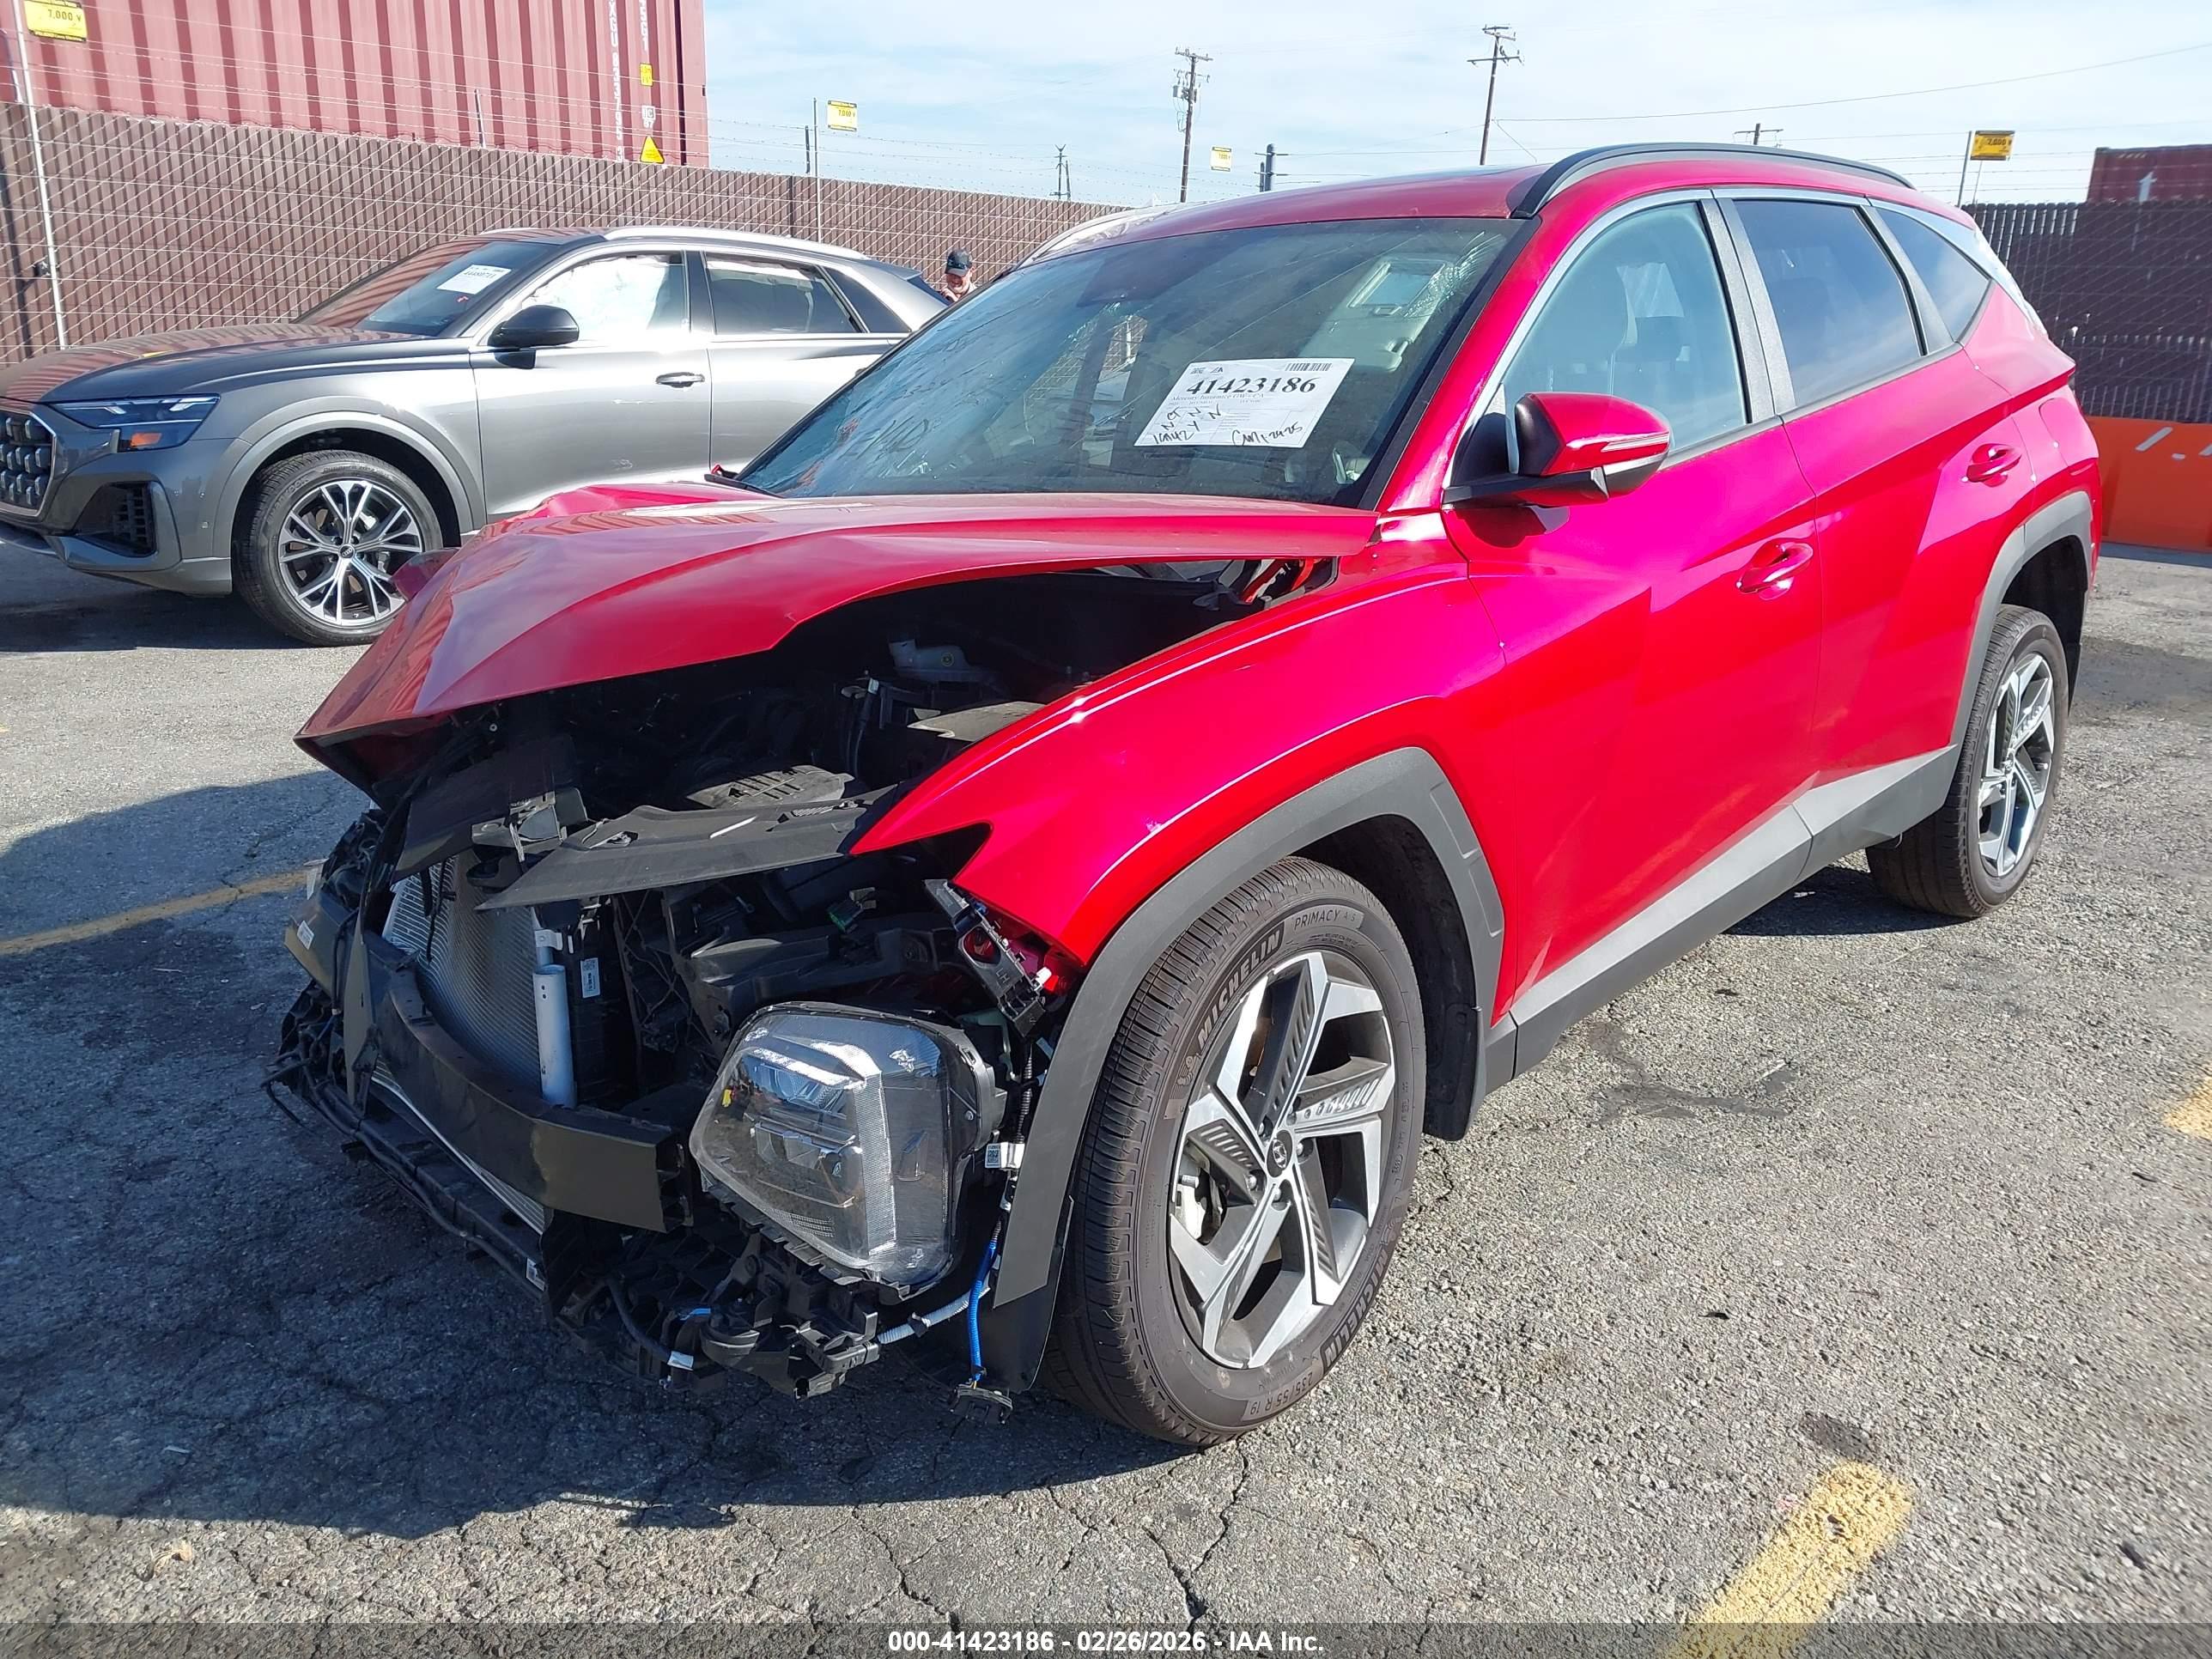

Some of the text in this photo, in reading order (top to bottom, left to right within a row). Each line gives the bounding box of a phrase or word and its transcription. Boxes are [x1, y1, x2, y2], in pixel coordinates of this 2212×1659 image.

[1187, 377, 1320, 395] 41423186
[1294, 909, 1341, 931] PRIMACY
[1198, 930, 1280, 1049] MICHELIN
[1323, 1249, 1389, 1370] MICHELIN
[1276, 1371, 1314, 1407] 235/55
[1249, 1401, 1262, 1415] 19
[1264, 1395, 1273, 1407] R
